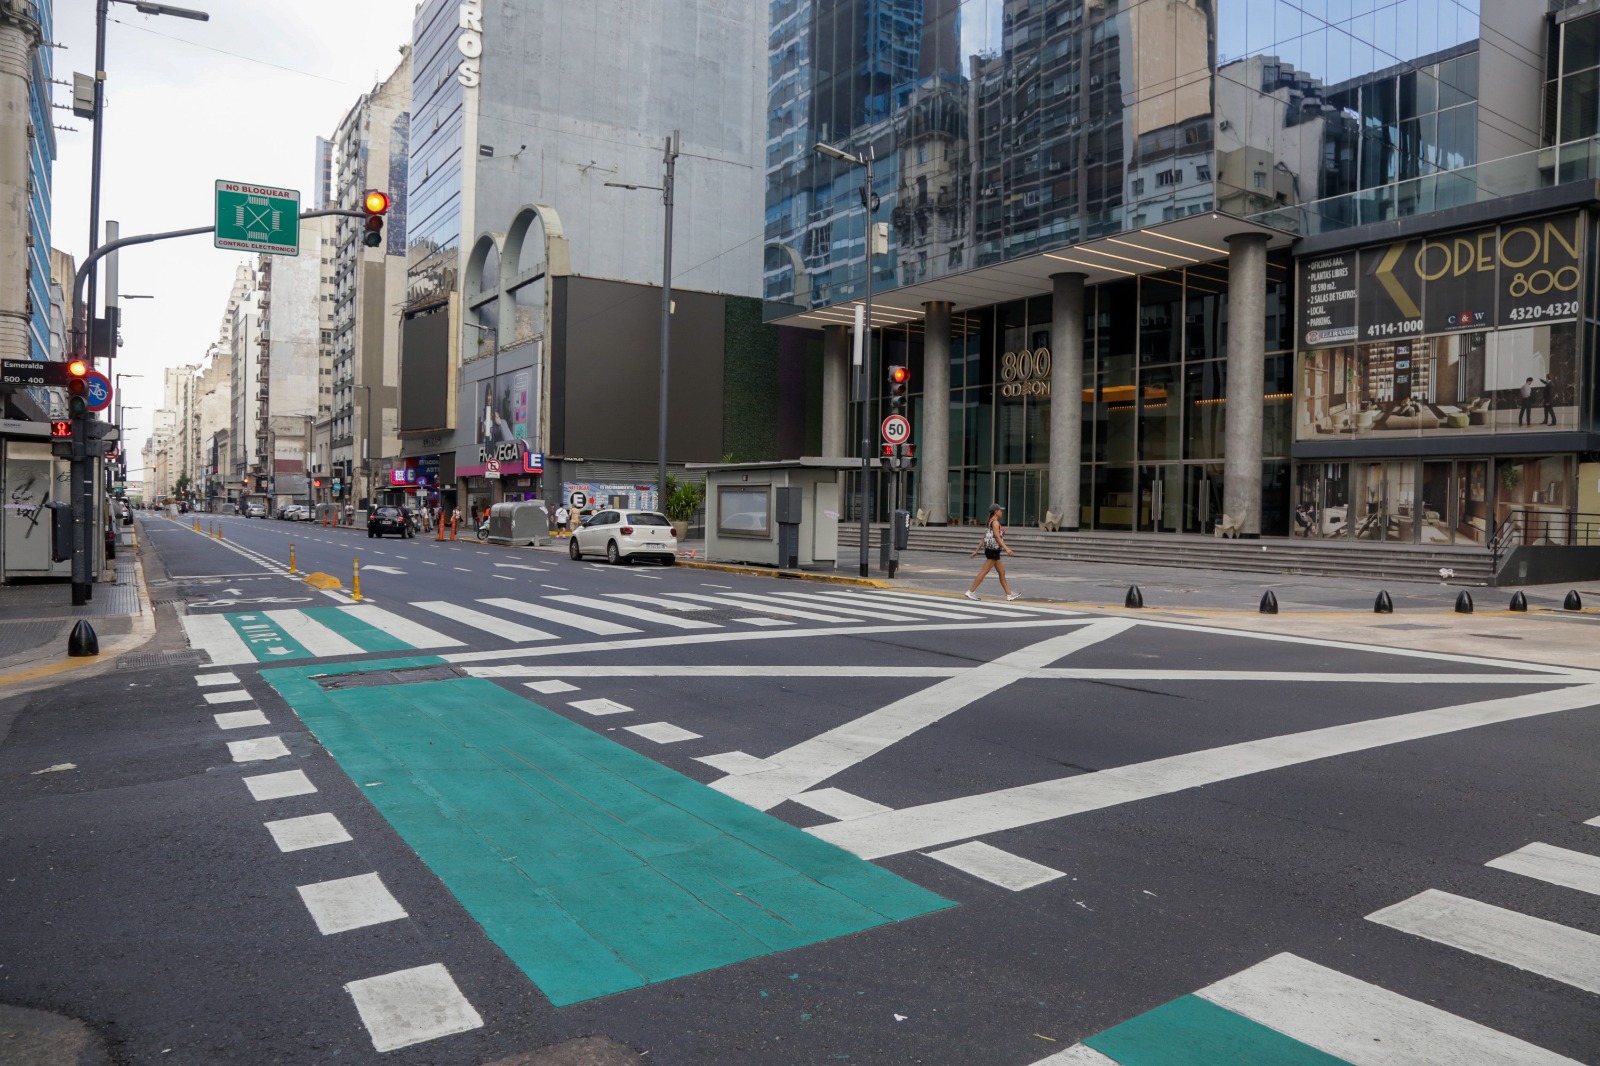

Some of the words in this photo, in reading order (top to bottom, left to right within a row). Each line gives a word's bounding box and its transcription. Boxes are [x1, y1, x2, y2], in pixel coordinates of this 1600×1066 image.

[457, 0, 483, 88] ROS
[225, 184, 239, 192] NO
[242, 186, 290, 198] BLOQUEAR
[218, 240, 249, 248] CONTROL
[251, 243, 296, 253] ELECTRONICO
[1414, 217, 1579, 281] ODEON
[1310, 258, 1332, 270] OFICINAS
[1310, 269, 1331, 281] PLANTAS
[1332, 267, 1349, 278] LIBRES
[1509, 265, 1580, 297] 800
[1310, 283, 1317, 293] DE
[1310, 296, 1314, 304] 2
[1314, 293, 1329, 303] SALAS
[1329, 292, 1335, 301] DE
[1336, 289, 1358, 300] TEATROS.
[1310, 305, 1326, 315] LOCAL.
[1509, 301, 1579, 320] 4320-4320
[1310, 316, 1332, 327] PARKING.
[1448, 315, 1456, 324] C
[1461, 314, 1469, 322] &
[1474, 312, 1485, 320] W
[1367, 320, 1424, 336] 4114-1000
[4, 362, 44, 370] Esmeralda
[1001, 347, 1051, 382] 800
[888, 423, 904, 436] 50
[530, 453, 542, 467] E
[407, 469, 414, 481] E
[573, 493, 584, 508] E
